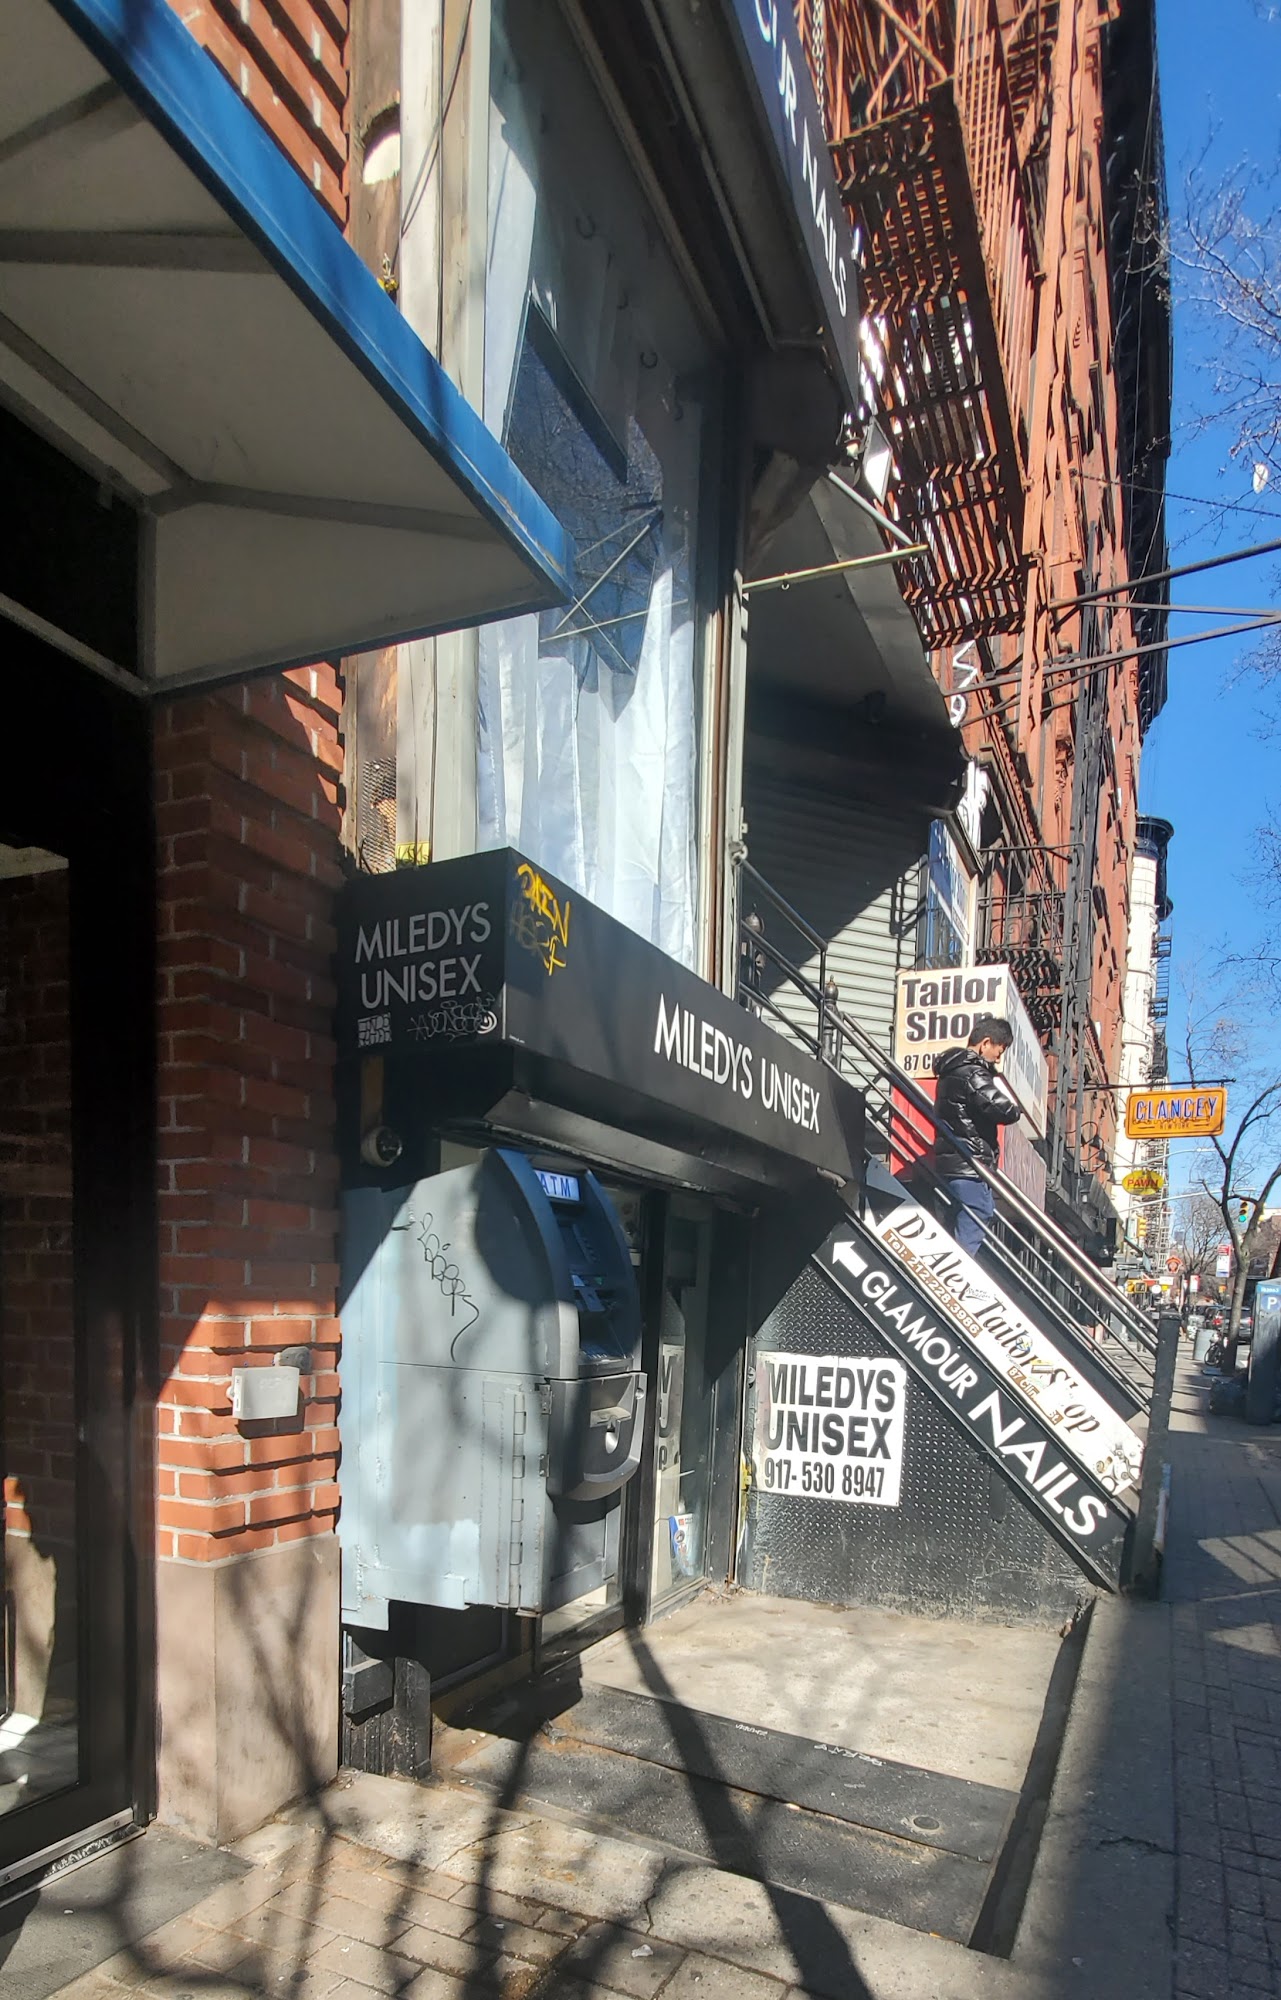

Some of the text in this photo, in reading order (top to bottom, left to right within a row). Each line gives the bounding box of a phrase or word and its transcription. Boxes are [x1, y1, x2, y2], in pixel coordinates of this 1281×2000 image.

[802, 117, 847, 317] NAILS
[355, 902, 491, 964] MILEDYS
[361, 954, 482, 1009] UNISEX
[902, 975, 1002, 1008] Tailor
[653, 992, 820, 1134] MILEDYS UNISEX
[904, 1054, 919, 1072] 87
[1136, 1096, 1218, 1120] CLANCEY
[540, 1173, 571, 1198] ATM
[1127, 1178, 1159, 1189] PAWN
[889, 1232, 907, 1258] Tel:
[909, 1257, 980, 1335] 212.228.3986
[766, 1362, 896, 1413] MILEDYS
[972, 1296, 1039, 1367] Tailor
[1041, 1368, 1100, 1433] Sop
[1009, 1368, 1021, 1379] 87
[862, 1270, 1108, 1535] GLAMOUR NAILS
[762, 1410, 892, 1460] UNISEX
[764, 1458, 885, 1499] 917- 530 8947
